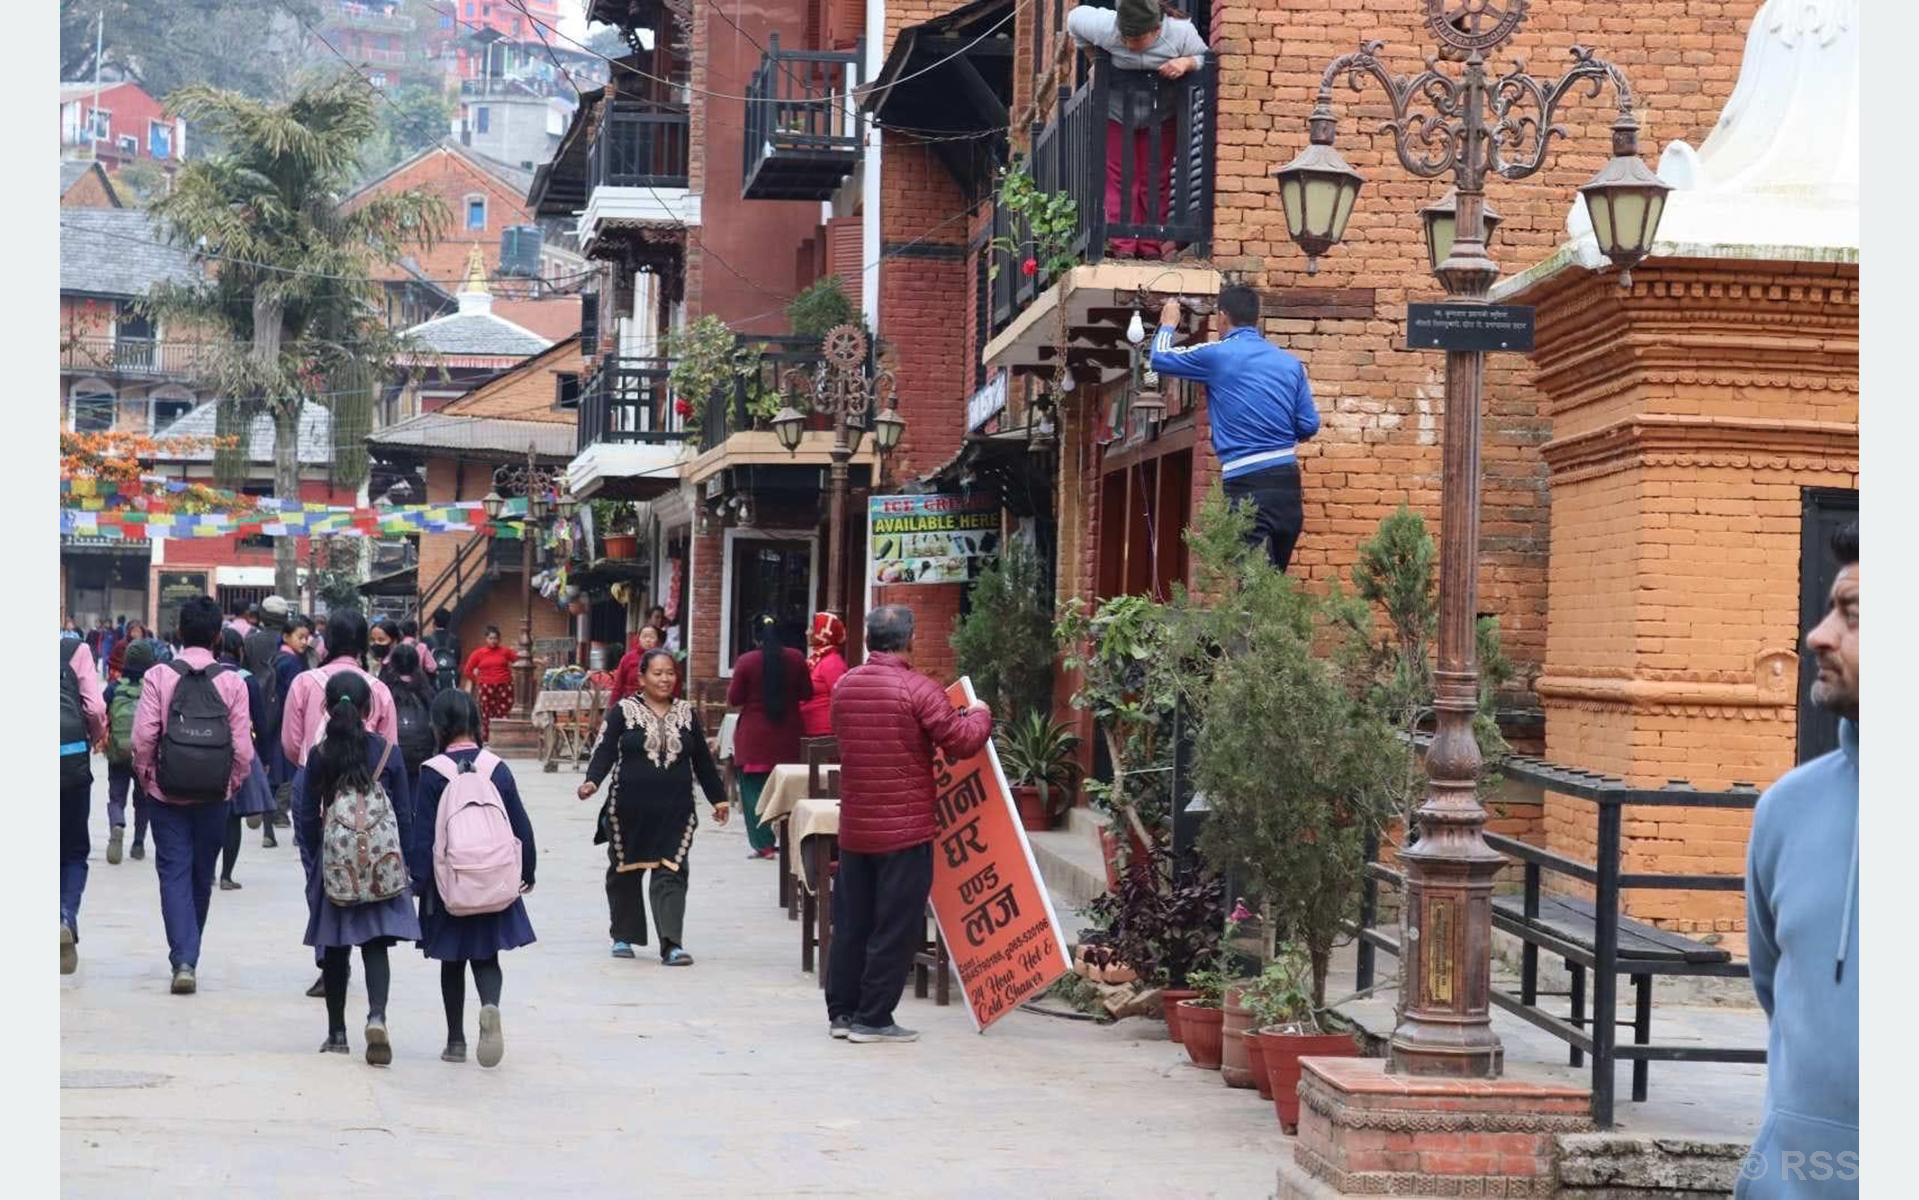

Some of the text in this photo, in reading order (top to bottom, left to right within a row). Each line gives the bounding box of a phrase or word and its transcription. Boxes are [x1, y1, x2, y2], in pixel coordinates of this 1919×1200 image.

[883, 499, 914, 512] ICE
[875, 513, 999, 532] AVAILABLE HERE
[940, 816, 988, 868] घर
[961, 883, 1020, 947] लज
[1018, 944, 1042, 972] Hot
